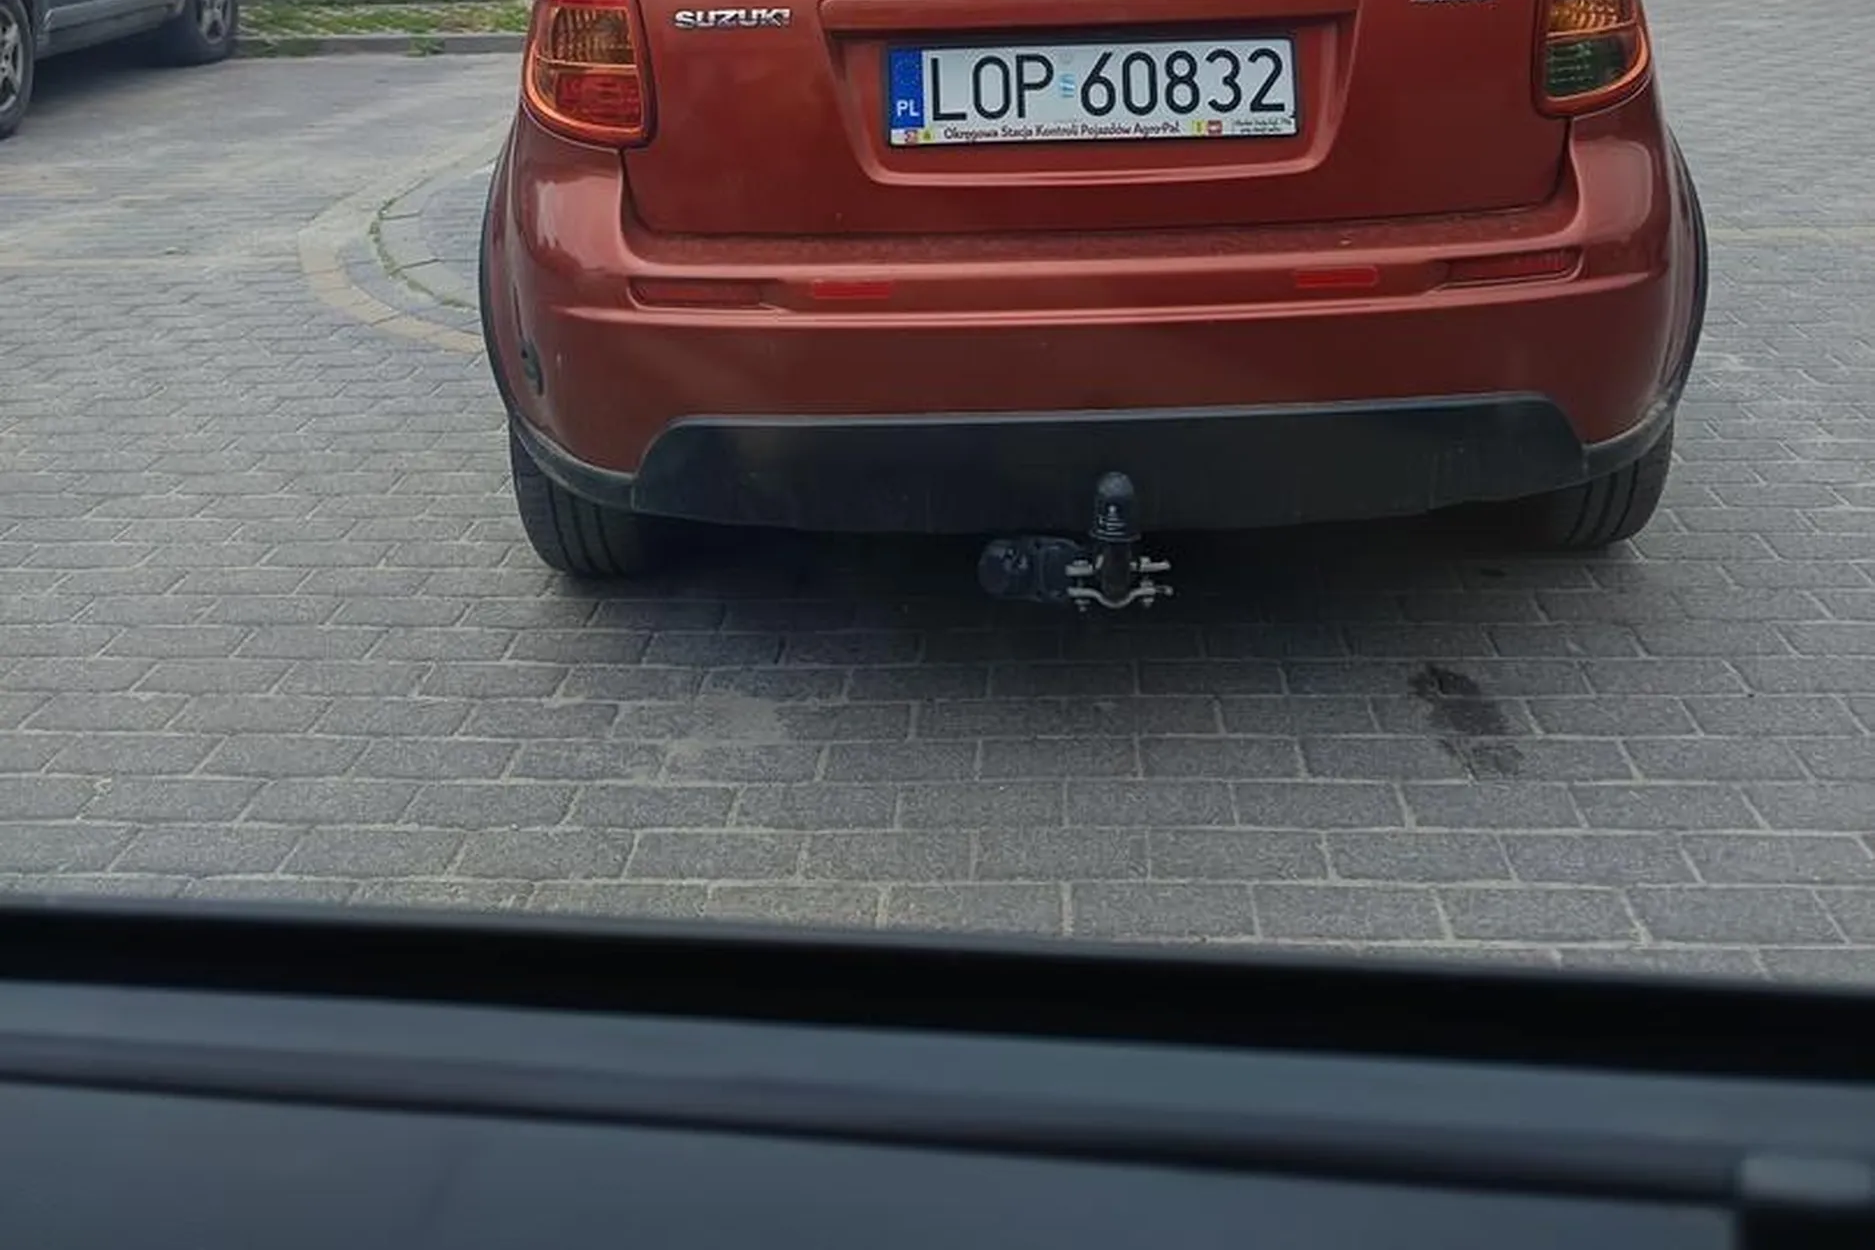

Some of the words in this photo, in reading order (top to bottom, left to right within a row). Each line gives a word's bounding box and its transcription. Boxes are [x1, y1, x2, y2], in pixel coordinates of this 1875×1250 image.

[675, 9, 791, 28] SUZUKI
[930, 53, 1055, 121] LOP
[1080, 48, 1286, 117] 60832
[896, 100, 920, 117] PL
[1001, 125, 1033, 139] Stacja
[1035, 121, 1078, 137] Kontroli
